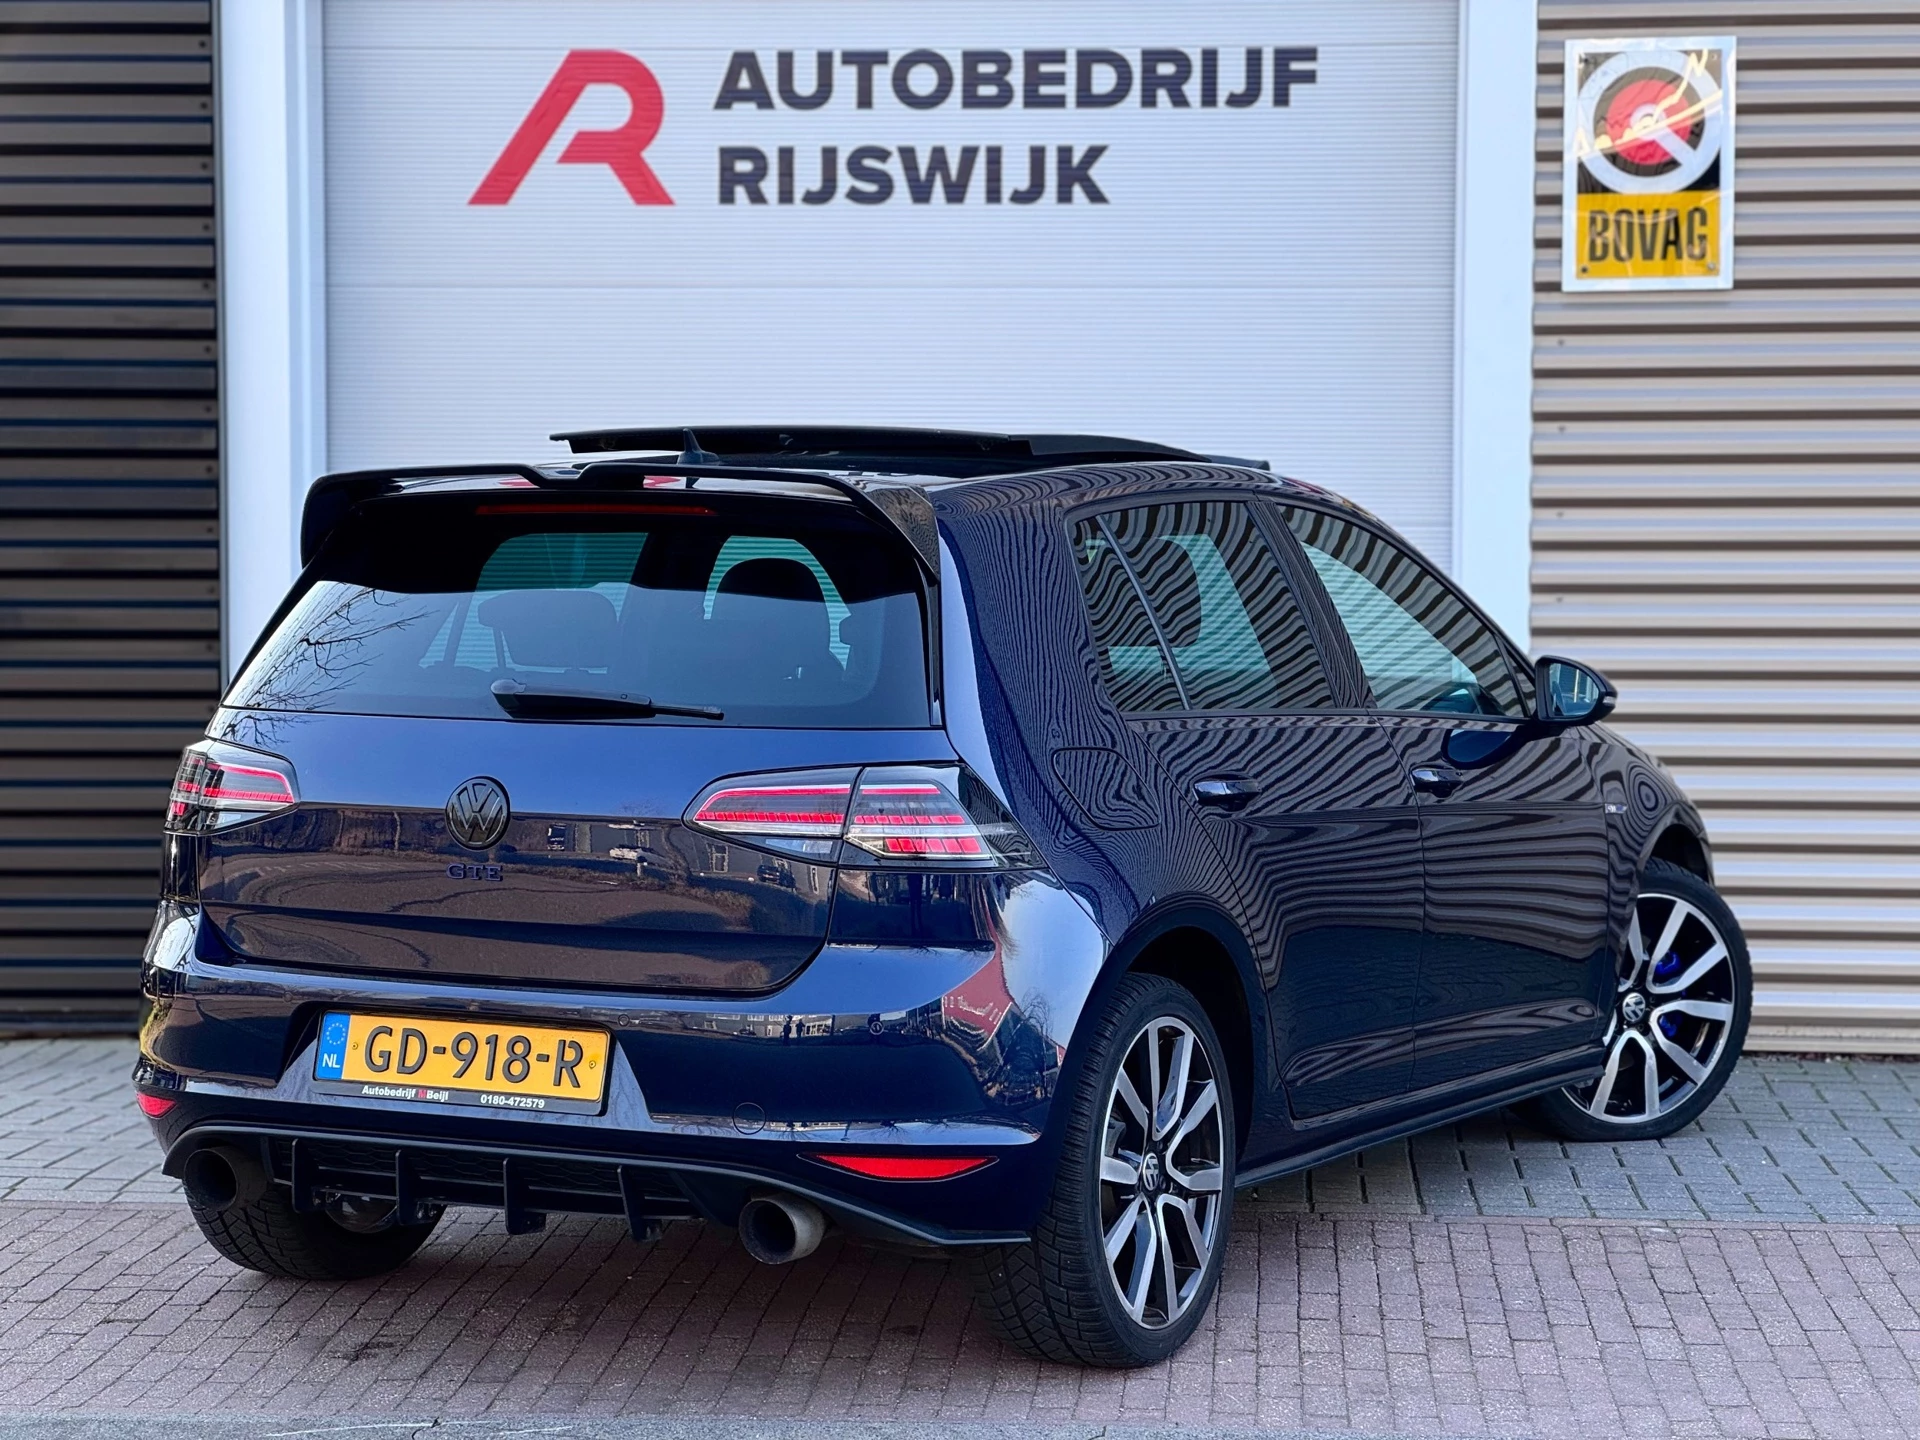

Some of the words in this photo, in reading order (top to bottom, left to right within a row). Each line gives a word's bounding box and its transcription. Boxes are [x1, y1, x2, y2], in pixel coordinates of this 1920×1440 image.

[713, 47, 1319, 111] AUTOBEDRIJF
[718, 145, 1110, 206] RIJSWIJK
[1588, 206, 1709, 263] BOVAG
[446, 863, 503, 881] GTE
[322, 1052, 341, 1069] NL
[364, 1025, 584, 1089] GD-918-R
[361, 1085, 416, 1100] Autobedrijf
[480, 1094, 545, 1108] 0180-472579
